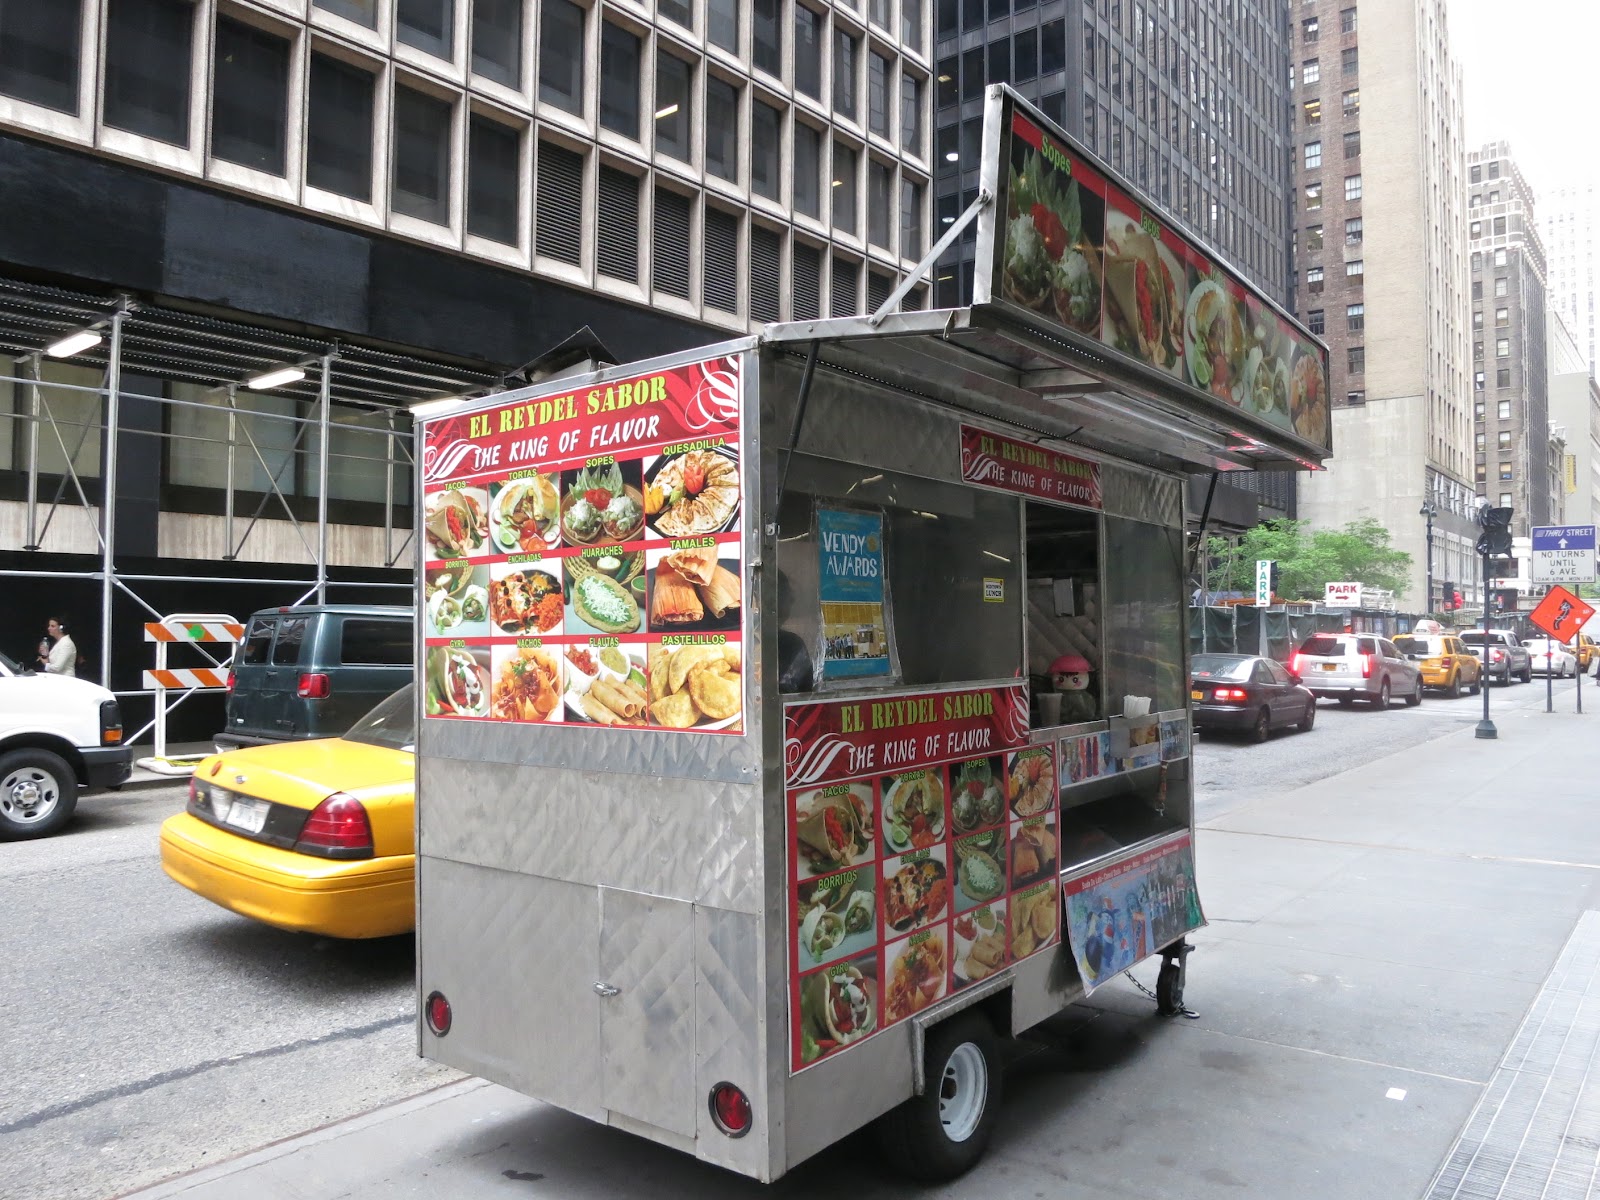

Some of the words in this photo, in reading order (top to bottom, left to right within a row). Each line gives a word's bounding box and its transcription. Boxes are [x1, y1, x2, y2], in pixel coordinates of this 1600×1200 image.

[1041, 135, 1071, 176] Sopes
[469, 414, 492, 439] EL
[499, 394, 578, 433] REYDEL
[587, 375, 667, 416] SABOR
[473, 443, 500, 469] THE
[508, 432, 548, 463] KING
[559, 428, 580, 453] OF
[590, 414, 660, 448] FLAVOR
[663, 437, 726, 456] QUESADILLA
[585, 455, 614, 468] SOPES
[980, 435, 997, 456] EL
[1002, 441, 1050, 470] REYDEL
[1054, 457, 1092, 480] SABOR
[508, 468, 538, 480] TORTAS
[444, 480, 467, 491] TACOS
[986, 464, 1005, 481] THE
[1011, 469, 1035, 488] KING
[1041, 476, 1052, 492] OF
[1057, 480, 1091, 500] FLAVOR
[1545, 529, 1564, 537] THRU
[1566, 528, 1593, 536] STREET
[669, 536, 715, 550] TAMALES
[823, 531, 866, 556] VENDY
[508, 553, 542, 564] ENCHILADAS
[581, 545, 623, 558] HUARACHES
[1556, 550, 1585, 558] TURNS
[826, 555, 878, 578] AWARDS
[1259, 561, 1267, 600] PARK
[1328, 585, 1357, 594] PARK
[449, 639, 466, 649] GYRO
[516, 638, 542, 648] NACHOS
[588, 636, 620, 648] FLAUTAS
[661, 634, 727, 646] PASTELILLOS
[841, 705, 865, 734] EL
[871, 698, 938, 730] REYDEL
[943, 692, 993, 719] SABOR
[848, 746, 874, 771] THE
[883, 739, 916, 765] KING
[925, 734, 940, 758] OF
[947, 727, 991, 755] FLAVOR
[966, 758, 986, 769] SOPES
[821, 784, 850, 798] TACOS
[817, 870, 858, 891] BORRITOS
[829, 961, 849, 978] GYRO
